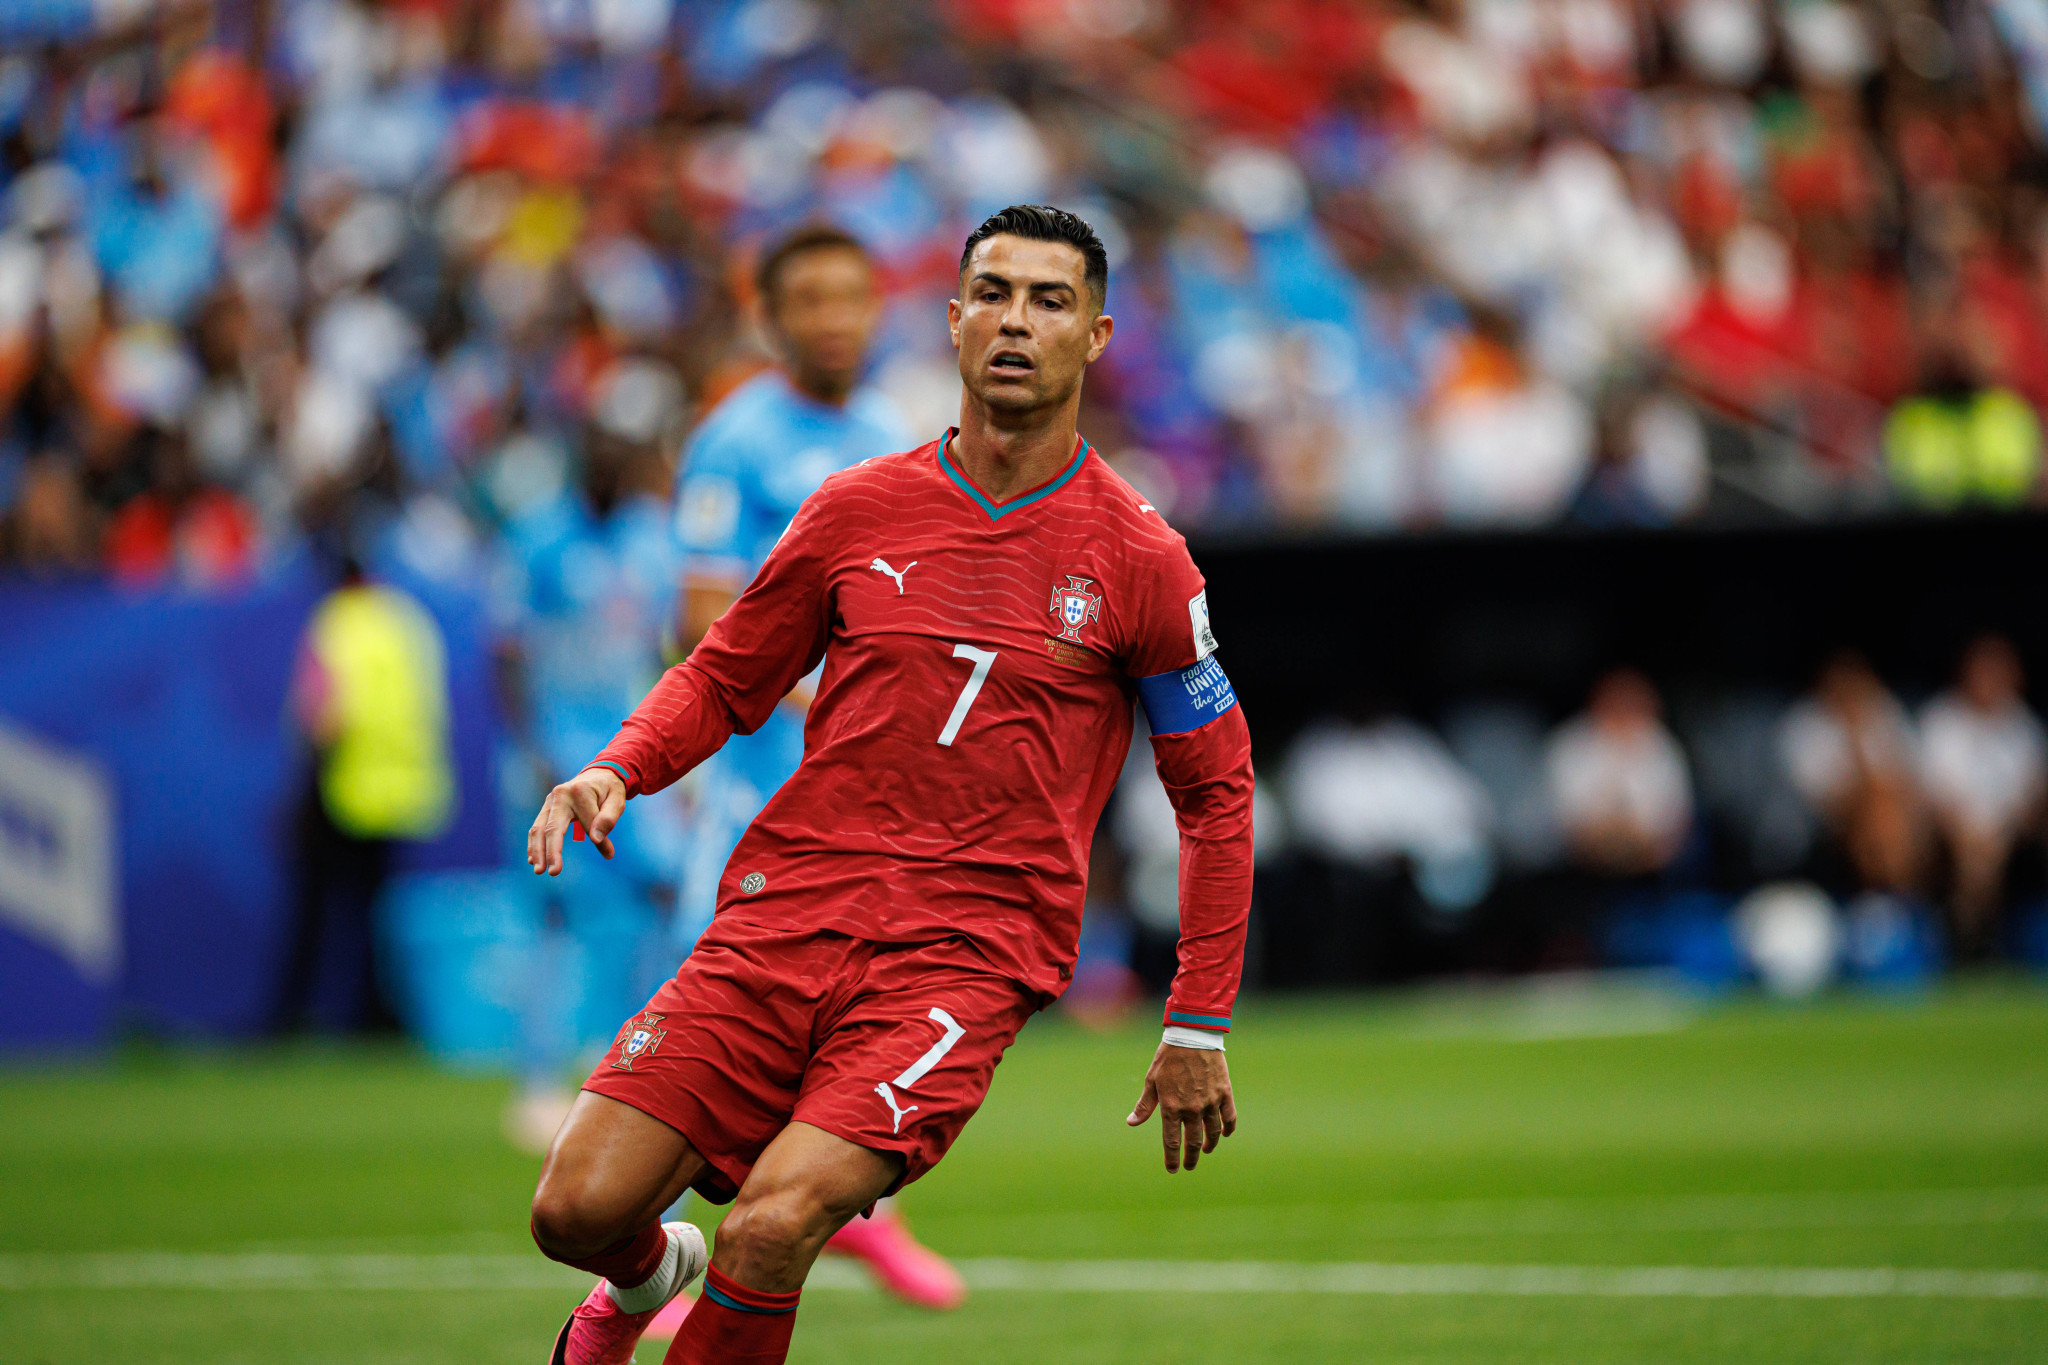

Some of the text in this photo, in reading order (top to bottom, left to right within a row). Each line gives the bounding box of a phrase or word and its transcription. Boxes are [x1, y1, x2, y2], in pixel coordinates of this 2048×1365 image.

[1044, 638, 1073, 651] PORTUGAL
[937, 644, 998, 746] 7
[1191, 694, 1214, 710] the
[1216, 695, 1233, 710] FIFA
[892, 1007, 966, 1089] 7
